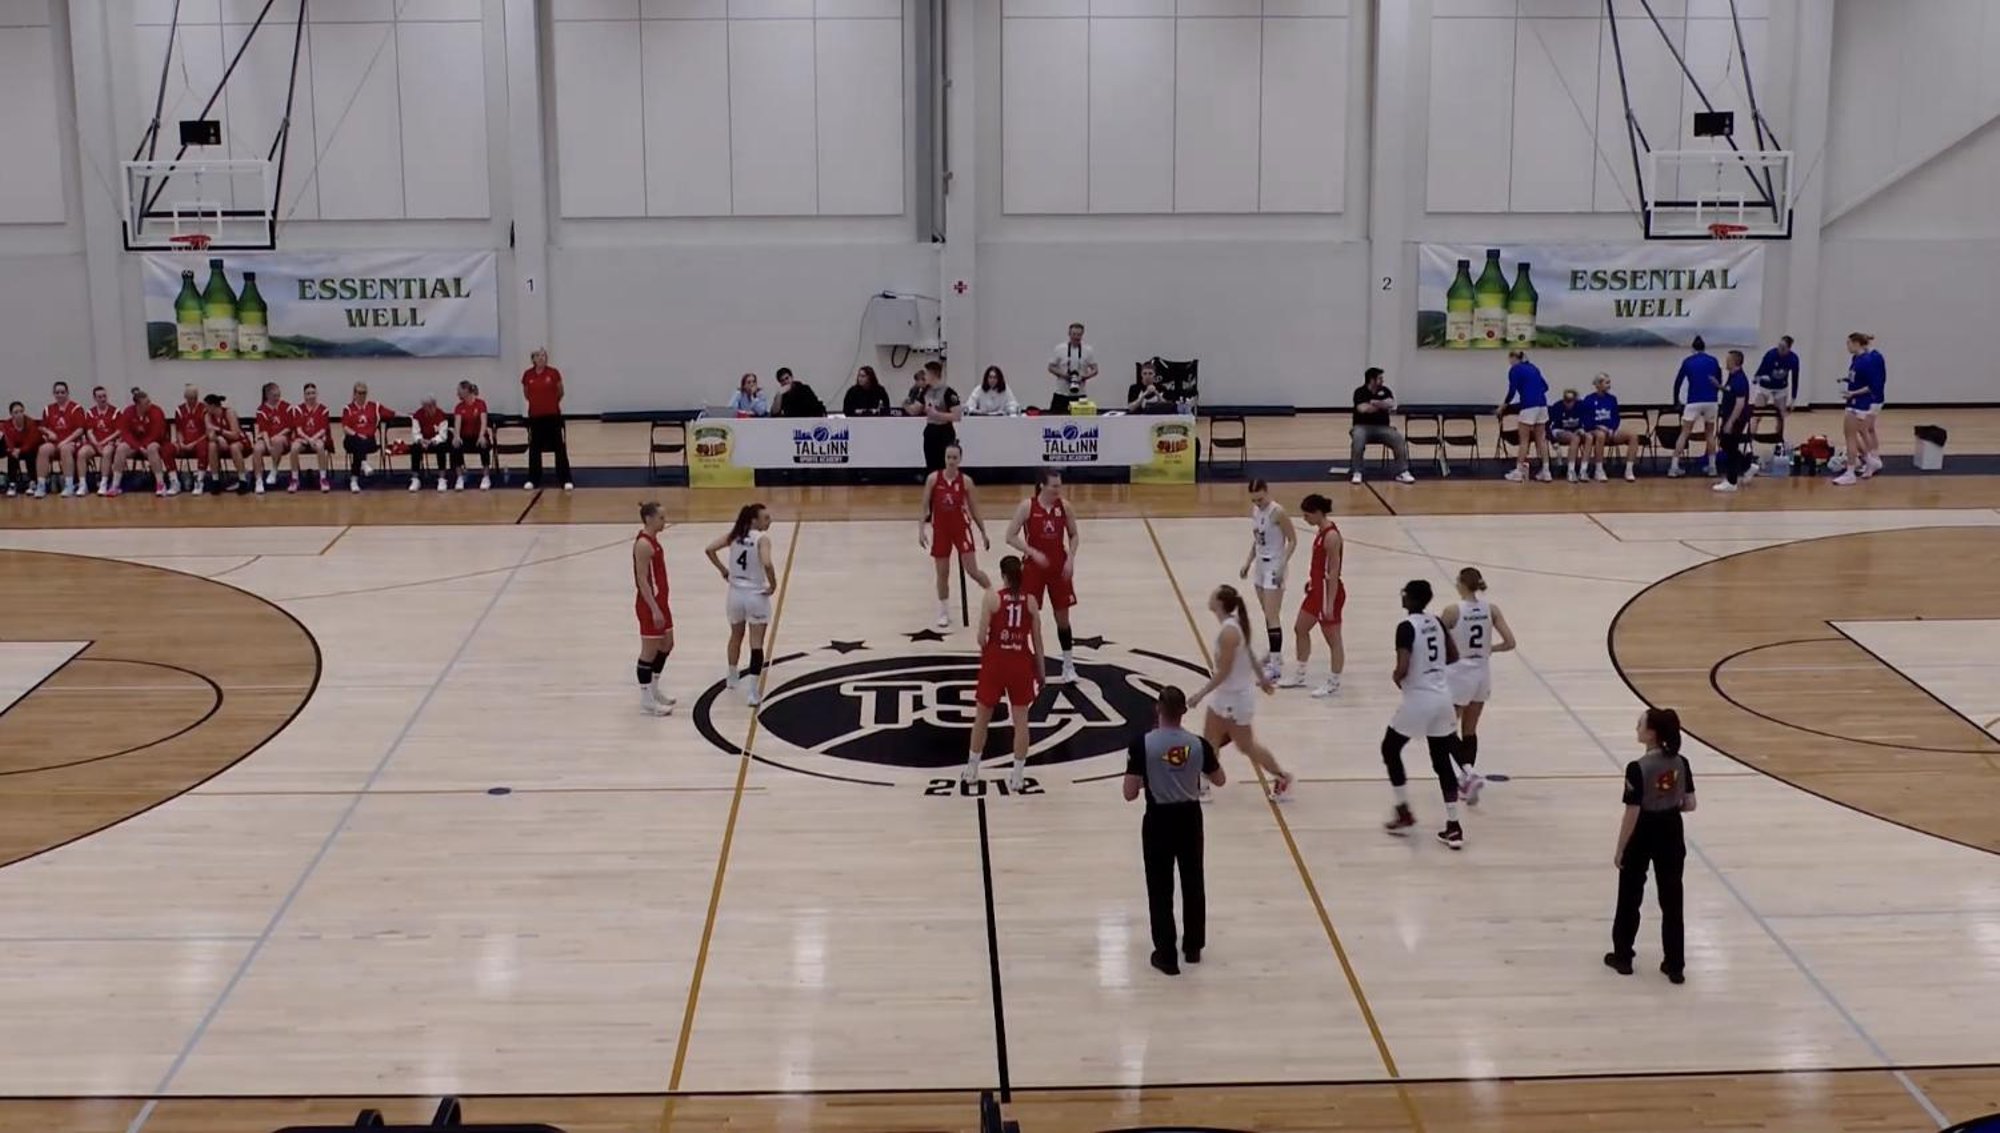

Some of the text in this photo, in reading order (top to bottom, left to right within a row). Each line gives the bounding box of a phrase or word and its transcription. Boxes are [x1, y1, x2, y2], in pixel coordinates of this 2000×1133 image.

[298, 277, 471, 300] ESSENTIAL
[526, 278, 534, 292] 1
[1382, 276, 1392, 291] 2
[1569, 268, 1738, 291] ESSENTIAL
[345, 307, 426, 327] WELL
[1614, 298, 1691, 318] WELL
[794, 441, 849, 455] TALLINN
[1044, 439, 1098, 454] TALLINN
[736, 549, 748, 571] 4
[1006, 603, 1023, 627] 11
[1469, 625, 1483, 648] 2
[1427, 637, 1438, 661] 5
[924, 777, 1046, 797] 2012
